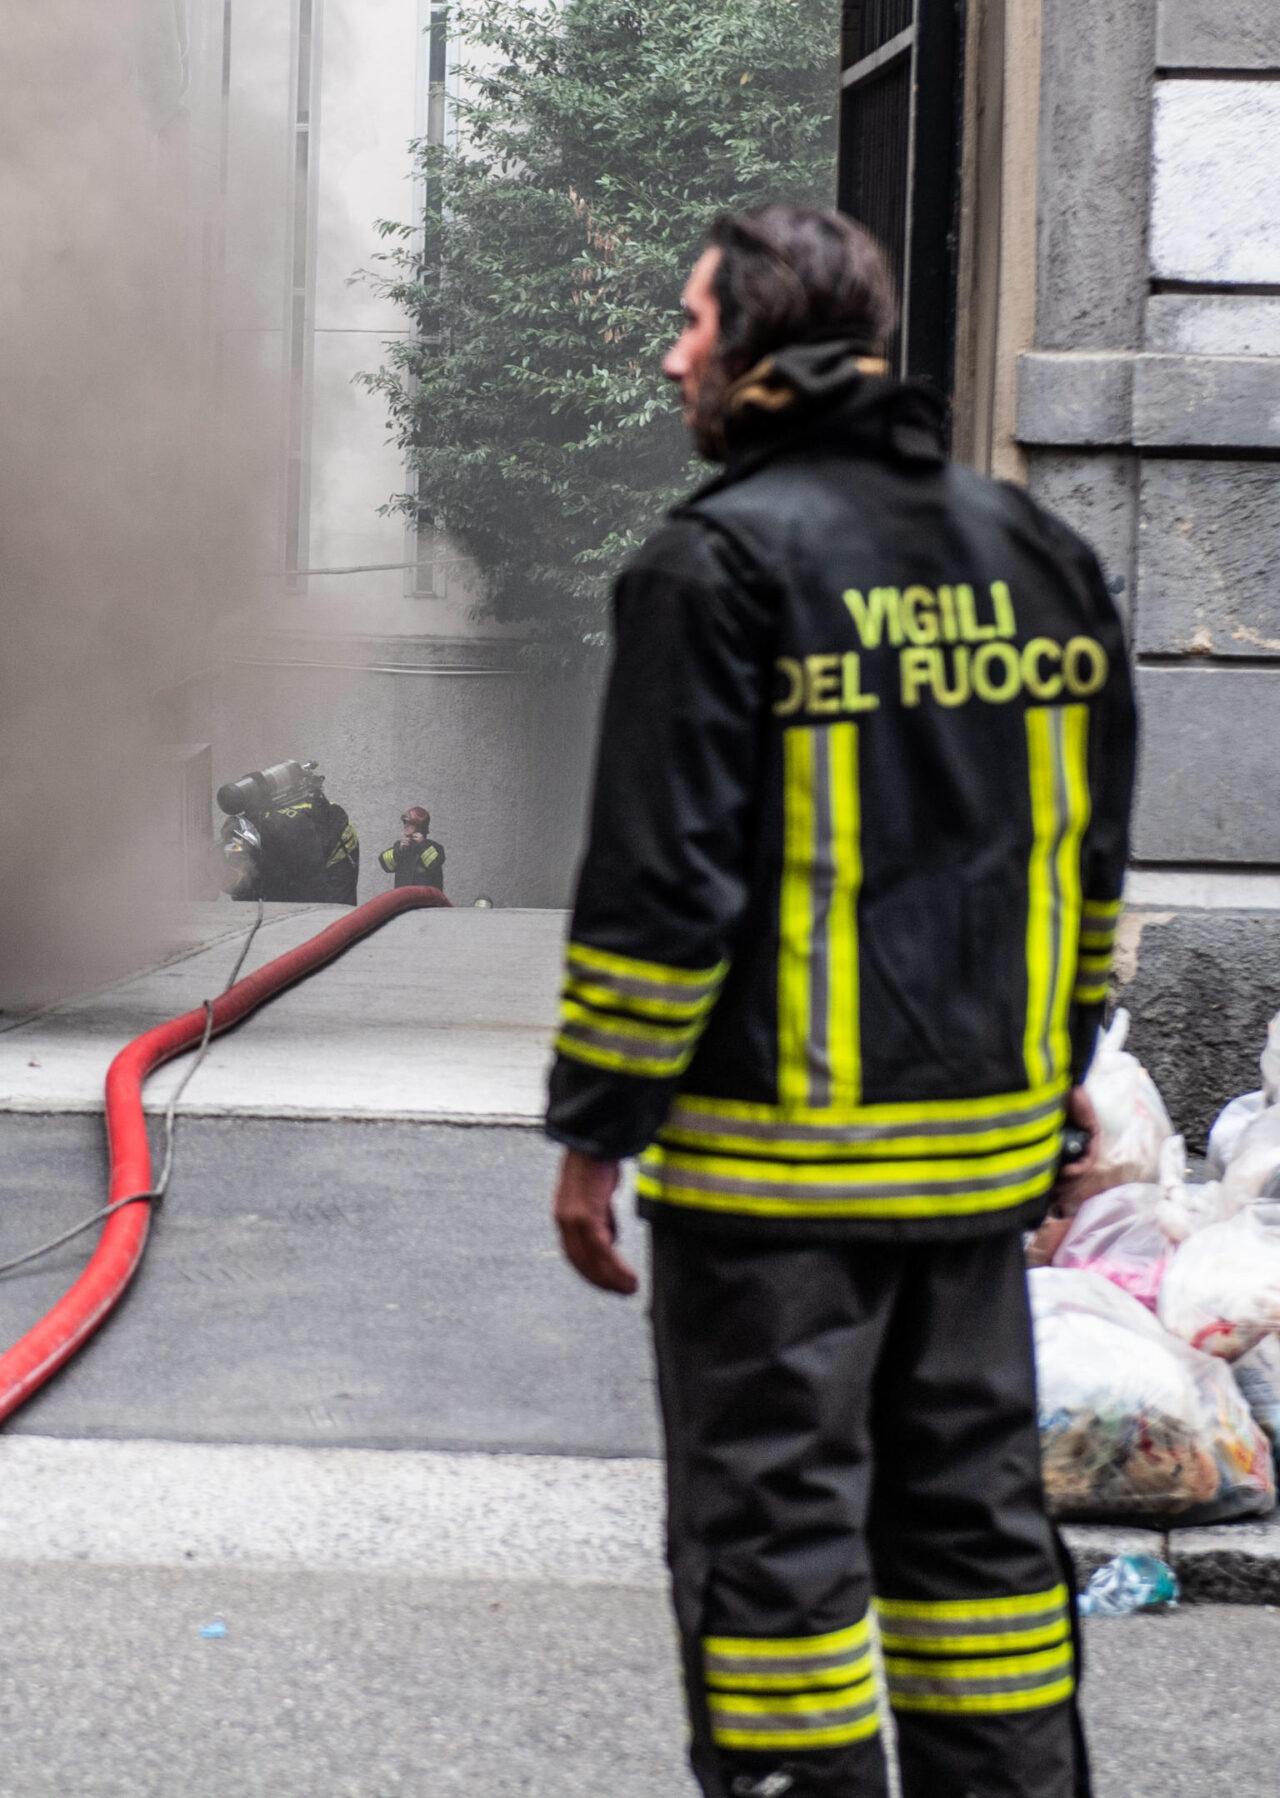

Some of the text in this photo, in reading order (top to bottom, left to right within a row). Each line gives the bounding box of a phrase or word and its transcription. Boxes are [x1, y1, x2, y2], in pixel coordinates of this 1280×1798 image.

[842, 580, 1017, 649] VIGILI
[772, 635, 1109, 716] DEL FUOCO
